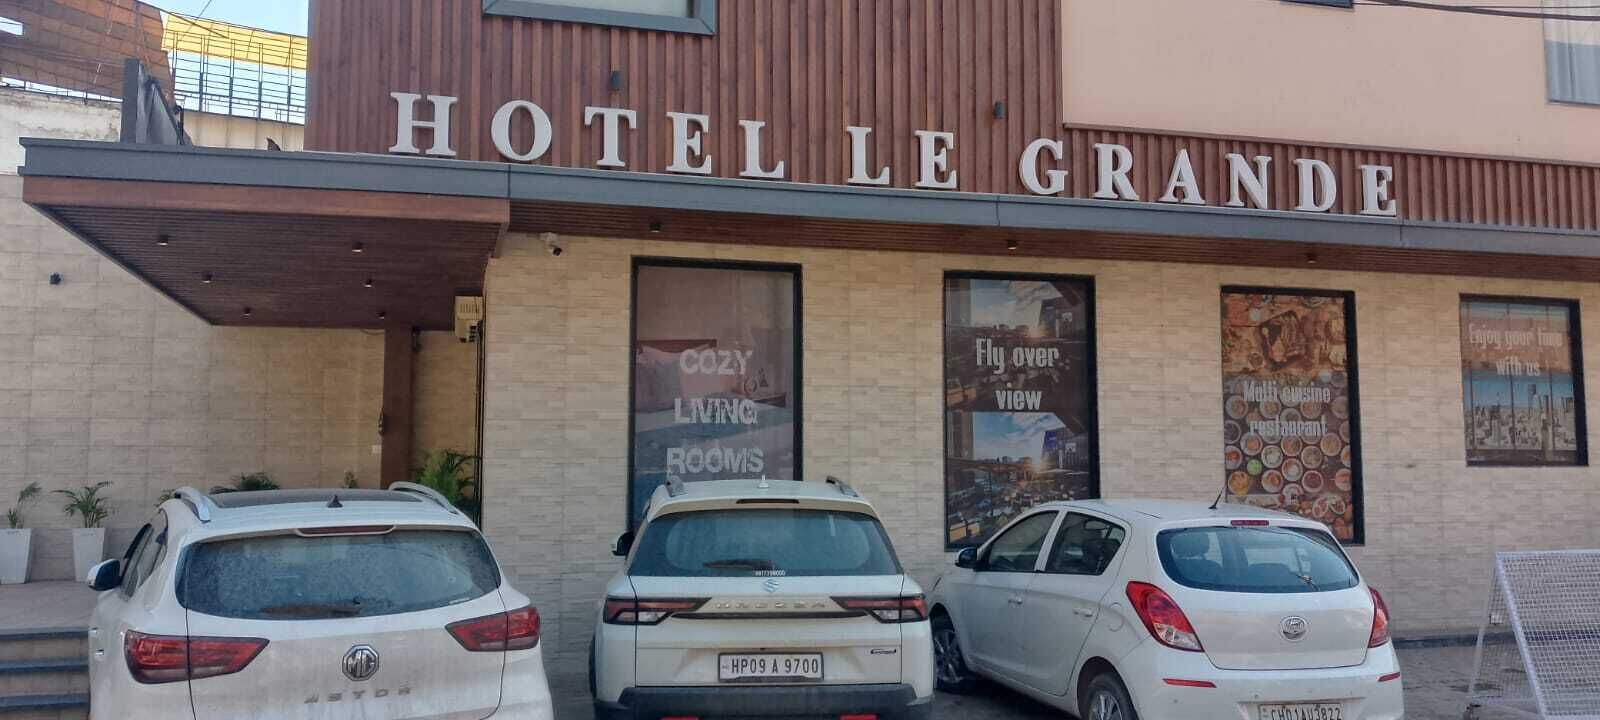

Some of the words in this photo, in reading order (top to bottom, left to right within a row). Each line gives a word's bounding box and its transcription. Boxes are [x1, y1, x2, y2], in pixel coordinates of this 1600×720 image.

[388, 91, 785, 179] HOTEL
[846, 126, 958, 189] LE
[1018, 137, 1398, 217] GRANDE
[1469, 323, 1502, 350] Enjoy
[1504, 331, 1534, 351] your
[1537, 326, 1564, 348] time
[680, 349, 752, 375] COZY
[976, 338, 1005, 374] Fly
[1013, 347, 1060, 368] over
[1496, 356, 1522, 376] with
[1526, 361, 1541, 376] us
[995, 384, 1042, 410] view
[1243, 381, 1277, 402] Multi
[1283, 381, 1331, 403] cuisine
[674, 398, 758, 424] LIVING
[1250, 415, 1329, 437] restaurant
[666, 447, 765, 474] ROOMS
[346, 648, 377, 679] MG
[731, 658, 766, 674] HP09
[772, 659, 778, 673] A
[784, 658, 819, 674] 9700
